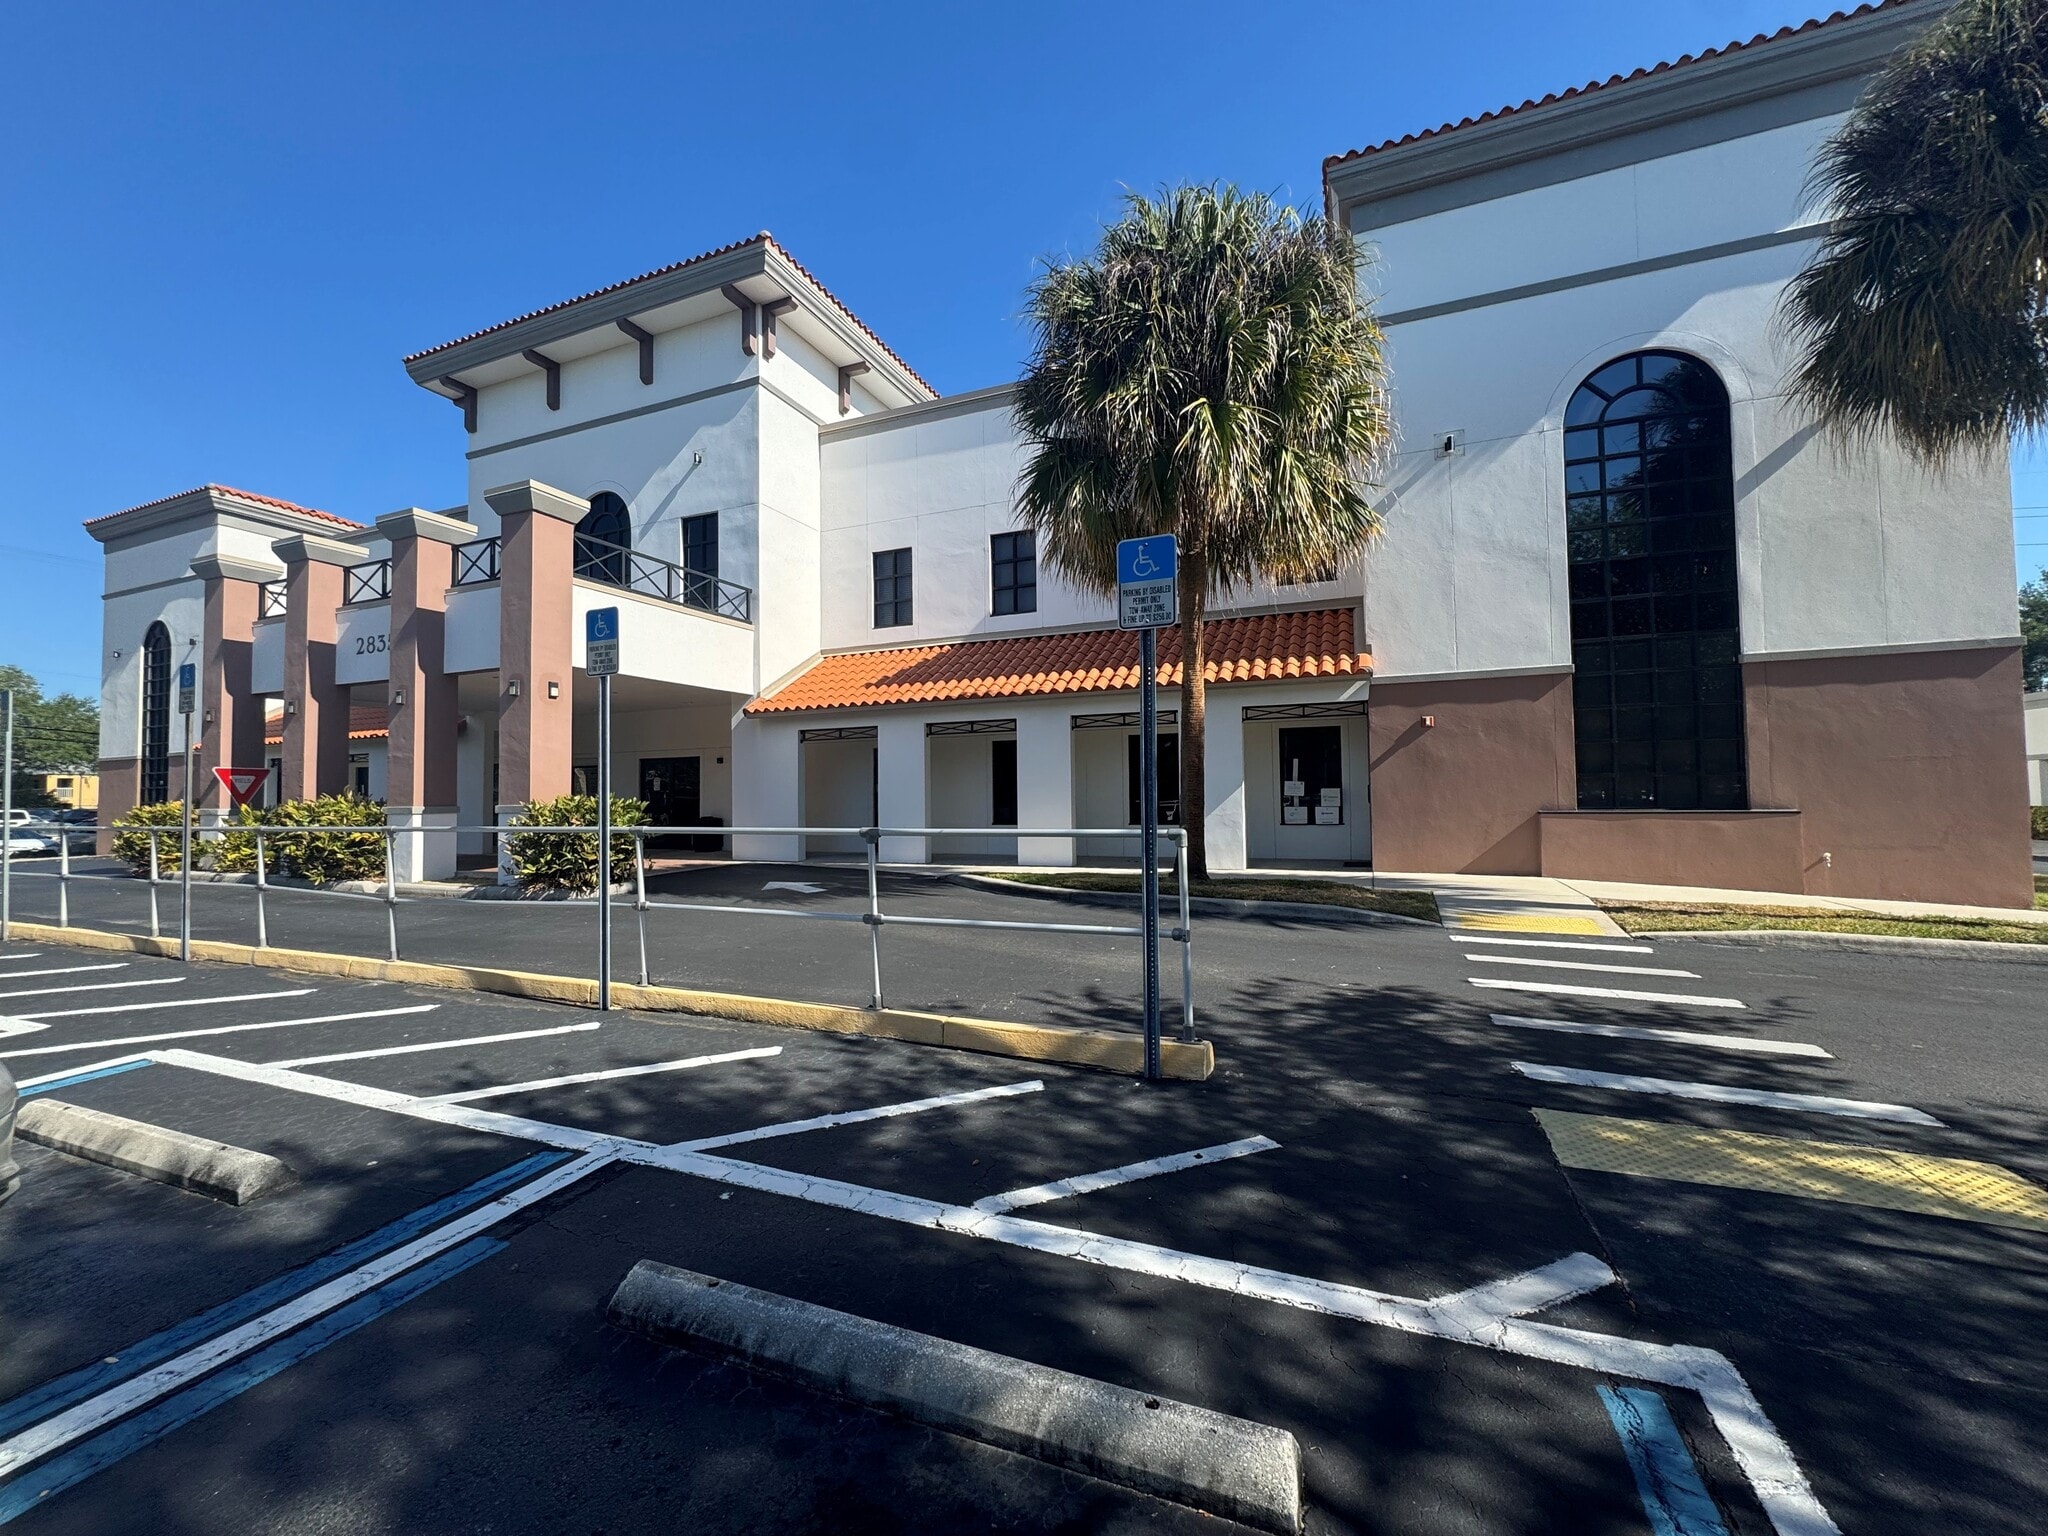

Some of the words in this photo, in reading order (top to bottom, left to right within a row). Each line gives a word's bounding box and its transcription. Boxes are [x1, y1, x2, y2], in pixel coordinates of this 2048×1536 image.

[1123, 588, 1141, 597] PARKING
[1142, 587, 1149, 596] BY
[1149, 585, 1171, 594] DISABLED
[1132, 596, 1149, 605] PERMIT
[1150, 595, 1161, 604] ONLY
[1153, 603, 1166, 612] ZONE
[1127, 615, 1138, 624] FINE
[1138, 614, 1145, 622] UP
[356, 633, 390, 656] 283
